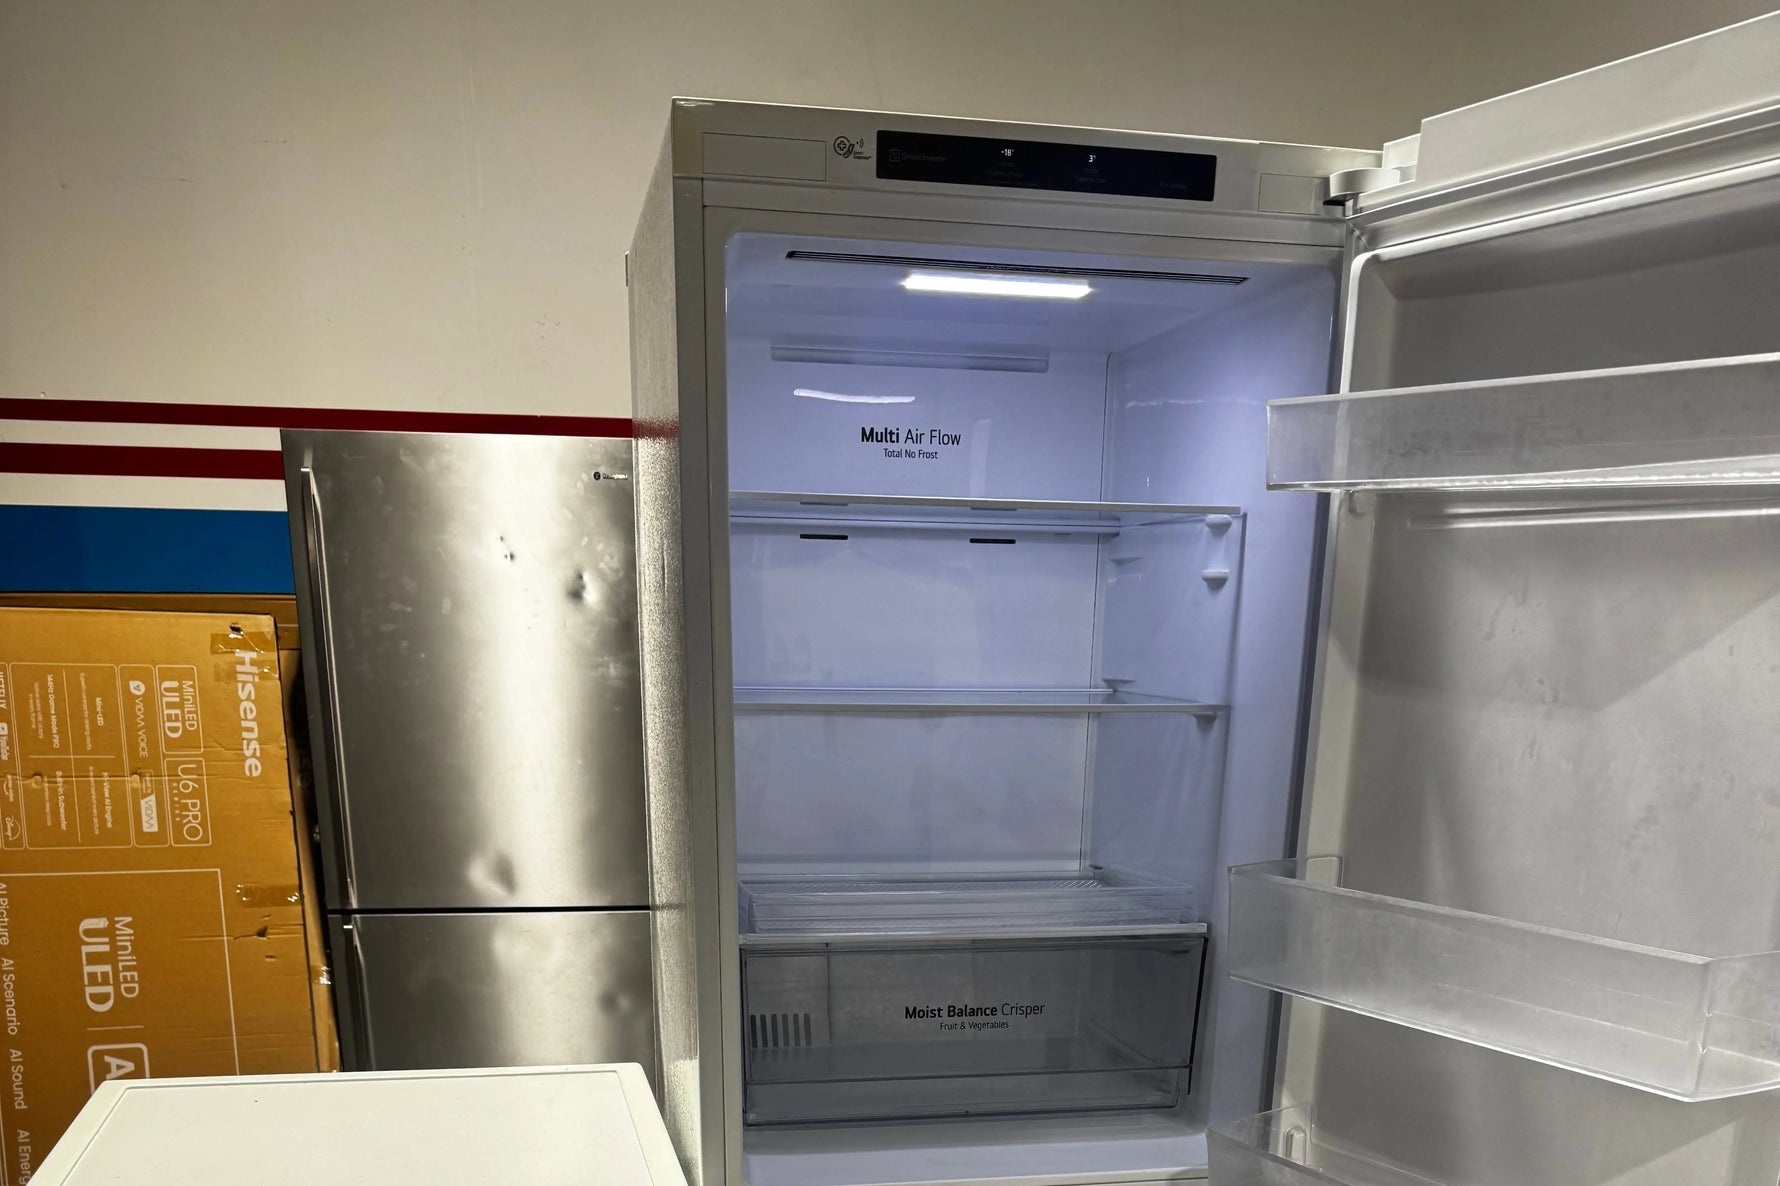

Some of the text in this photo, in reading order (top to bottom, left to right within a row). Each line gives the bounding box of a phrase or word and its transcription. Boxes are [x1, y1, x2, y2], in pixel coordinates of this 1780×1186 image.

[861, 427, 961, 446] Multi Air Flow
[883, 448, 938, 459] Total No Frost
[160, 680, 183, 739] ULED
[182, 680, 198, 731] MiniLED
[234, 650, 262, 777] Hisense
[138, 729, 148, 758] VOICE
[178, 764, 203, 841] U6 PRO
[1, 957, 13, 971] AI
[78, 917, 115, 1013] ULED
[114, 916, 139, 998] MiniLED
[2, 974, 20, 1035] Scenario
[905, 1002, 1046, 1020] Moist Balance Crisper
[940, 1021, 1009, 1032] Fruit & Vegetables
[10, 1048, 22, 1062] AI
[12, 1065, 28, 1110] Sound
[18, 1128, 30, 1142] AI
